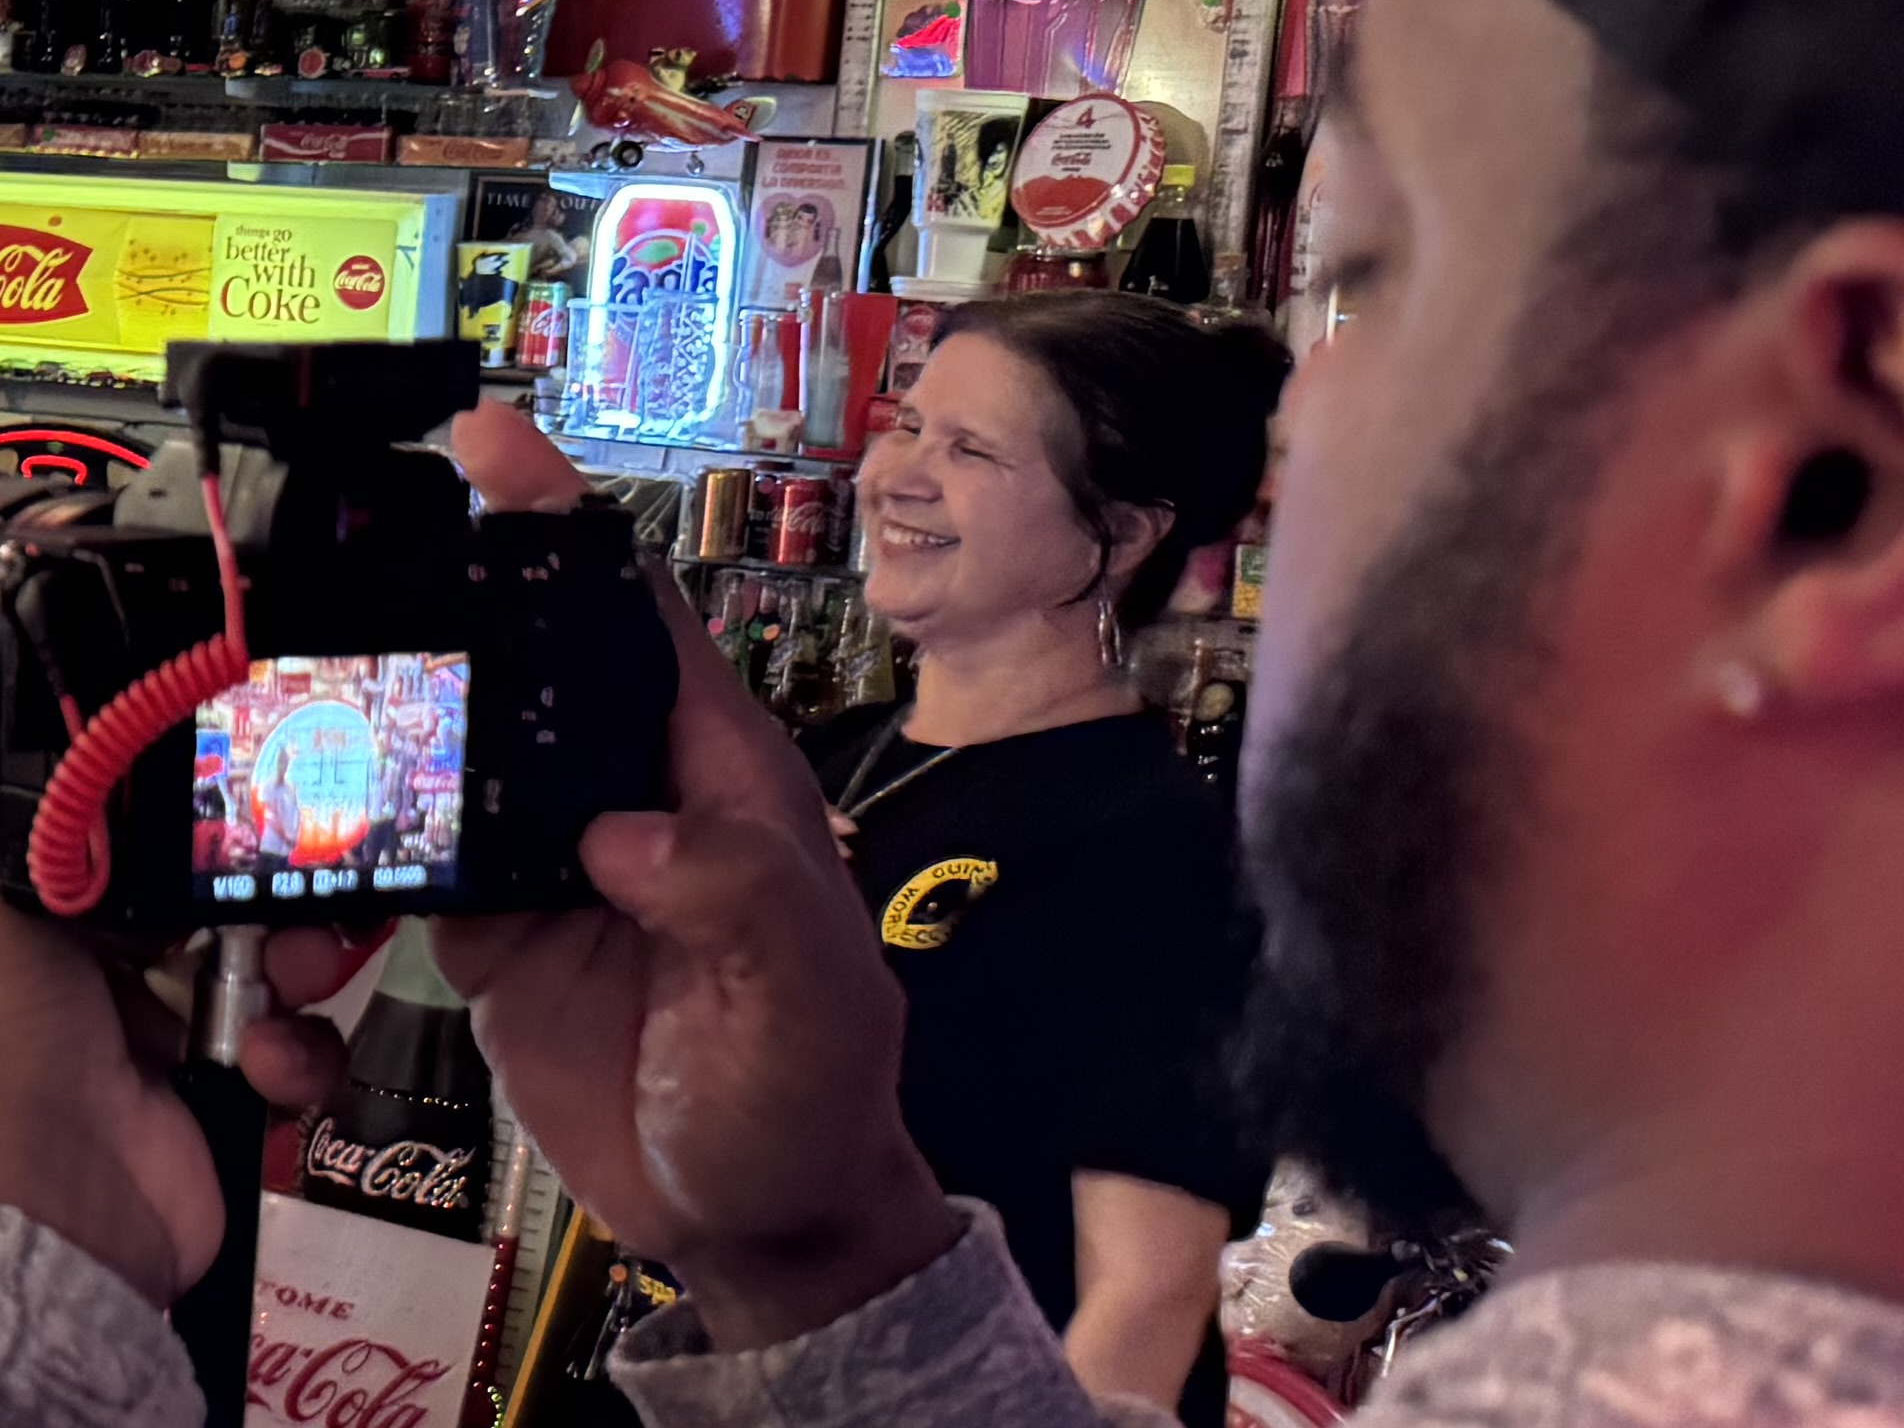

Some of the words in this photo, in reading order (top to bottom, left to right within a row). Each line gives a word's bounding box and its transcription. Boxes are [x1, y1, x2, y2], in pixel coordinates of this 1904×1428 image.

[225, 236, 291, 264] better
[235, 224, 271, 241] things
[272, 228, 292, 245] go
[252, 256, 316, 291] with
[220, 275, 321, 325] Coke
